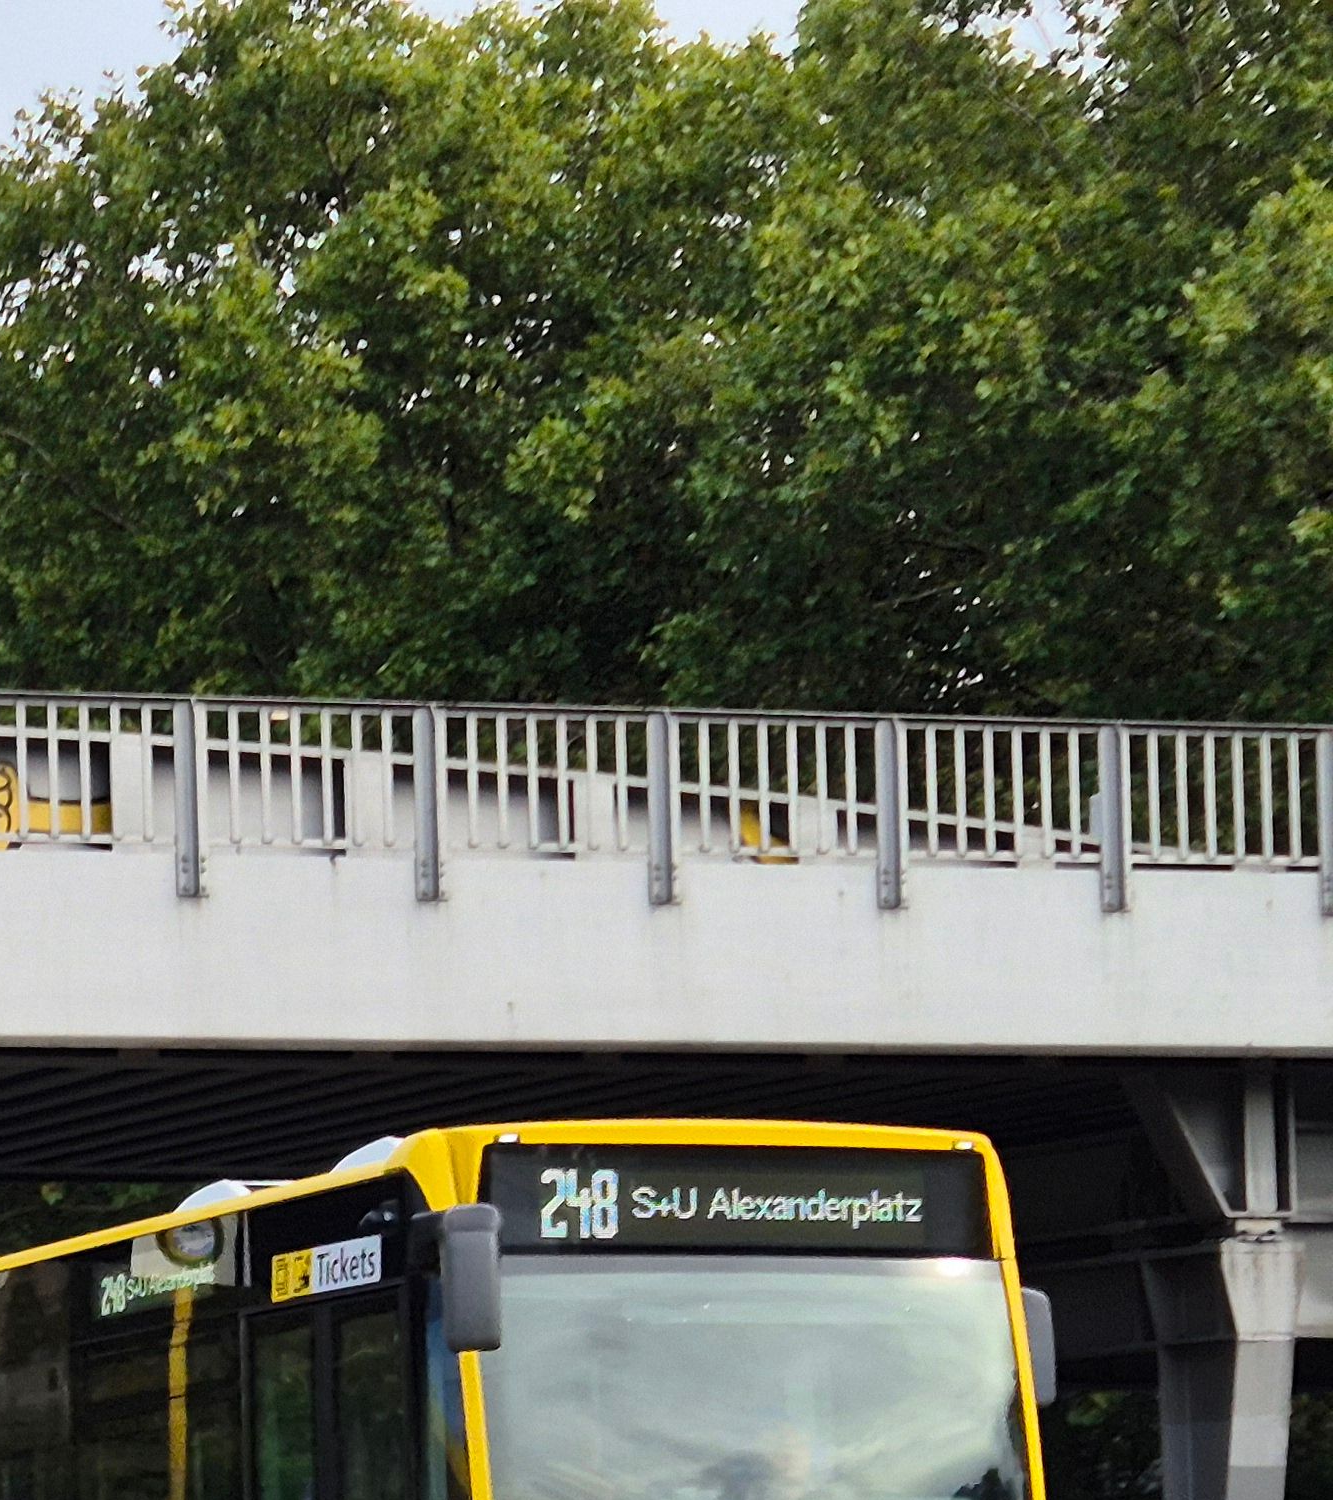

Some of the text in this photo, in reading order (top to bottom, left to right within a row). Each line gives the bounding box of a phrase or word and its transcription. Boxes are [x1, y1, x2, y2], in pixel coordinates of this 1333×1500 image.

[540, 1168, 924, 1239] 248 S+U Alexanderplatz
[316, 1247, 377, 1287] Tickets
